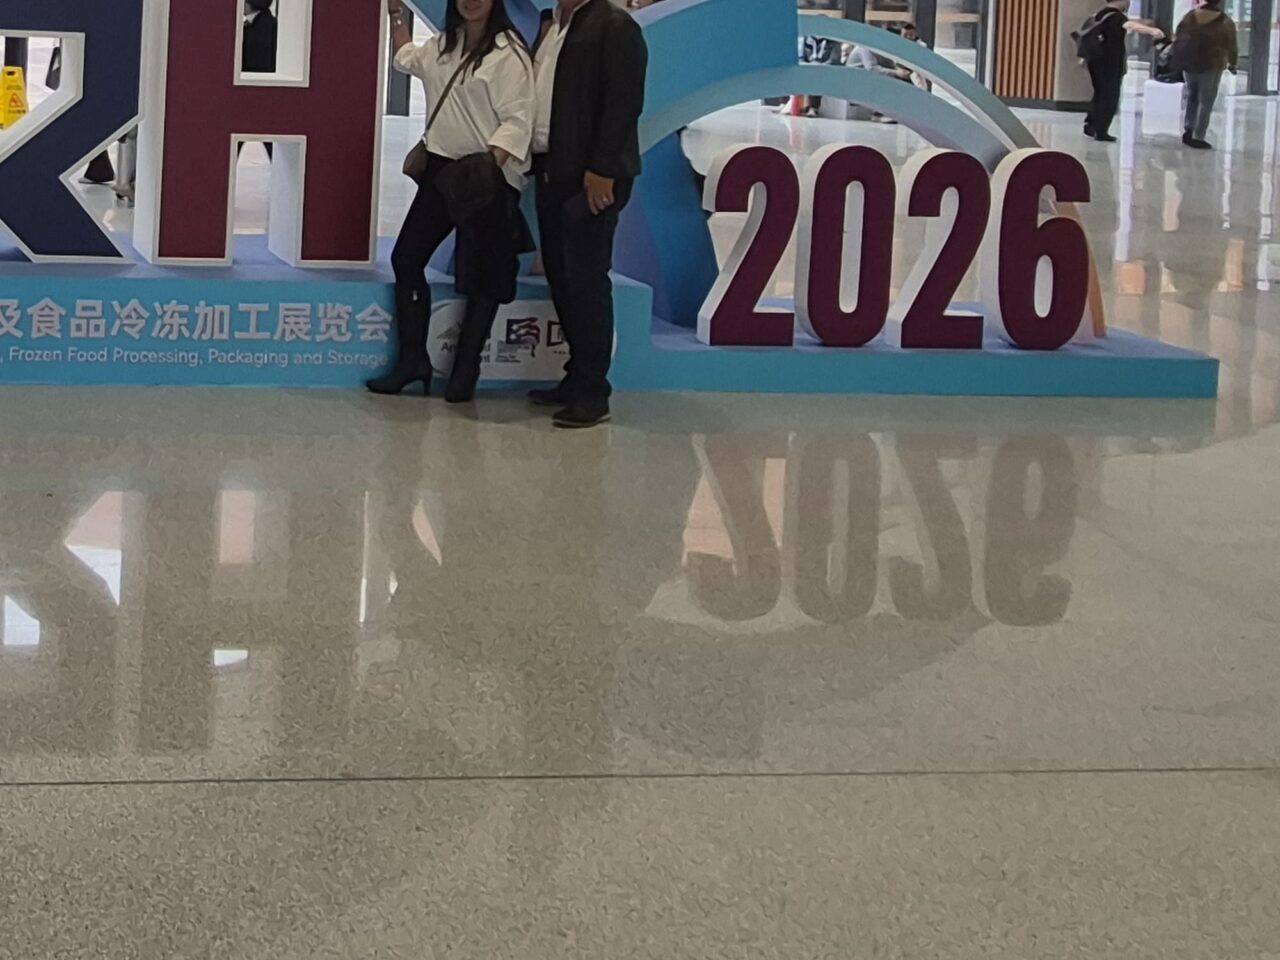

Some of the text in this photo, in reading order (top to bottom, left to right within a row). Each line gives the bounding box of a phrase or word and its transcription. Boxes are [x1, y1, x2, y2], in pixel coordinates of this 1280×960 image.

[703, 144, 1091, 349] 2026
[9, 346, 62, 362] Frozen
[68, 347, 108, 363] Food
[113, 348, 203, 367] Processing,
[208, 349, 288, 368] Packaging
[293, 351, 323, 366] and
[327, 351, 389, 369] Storage
